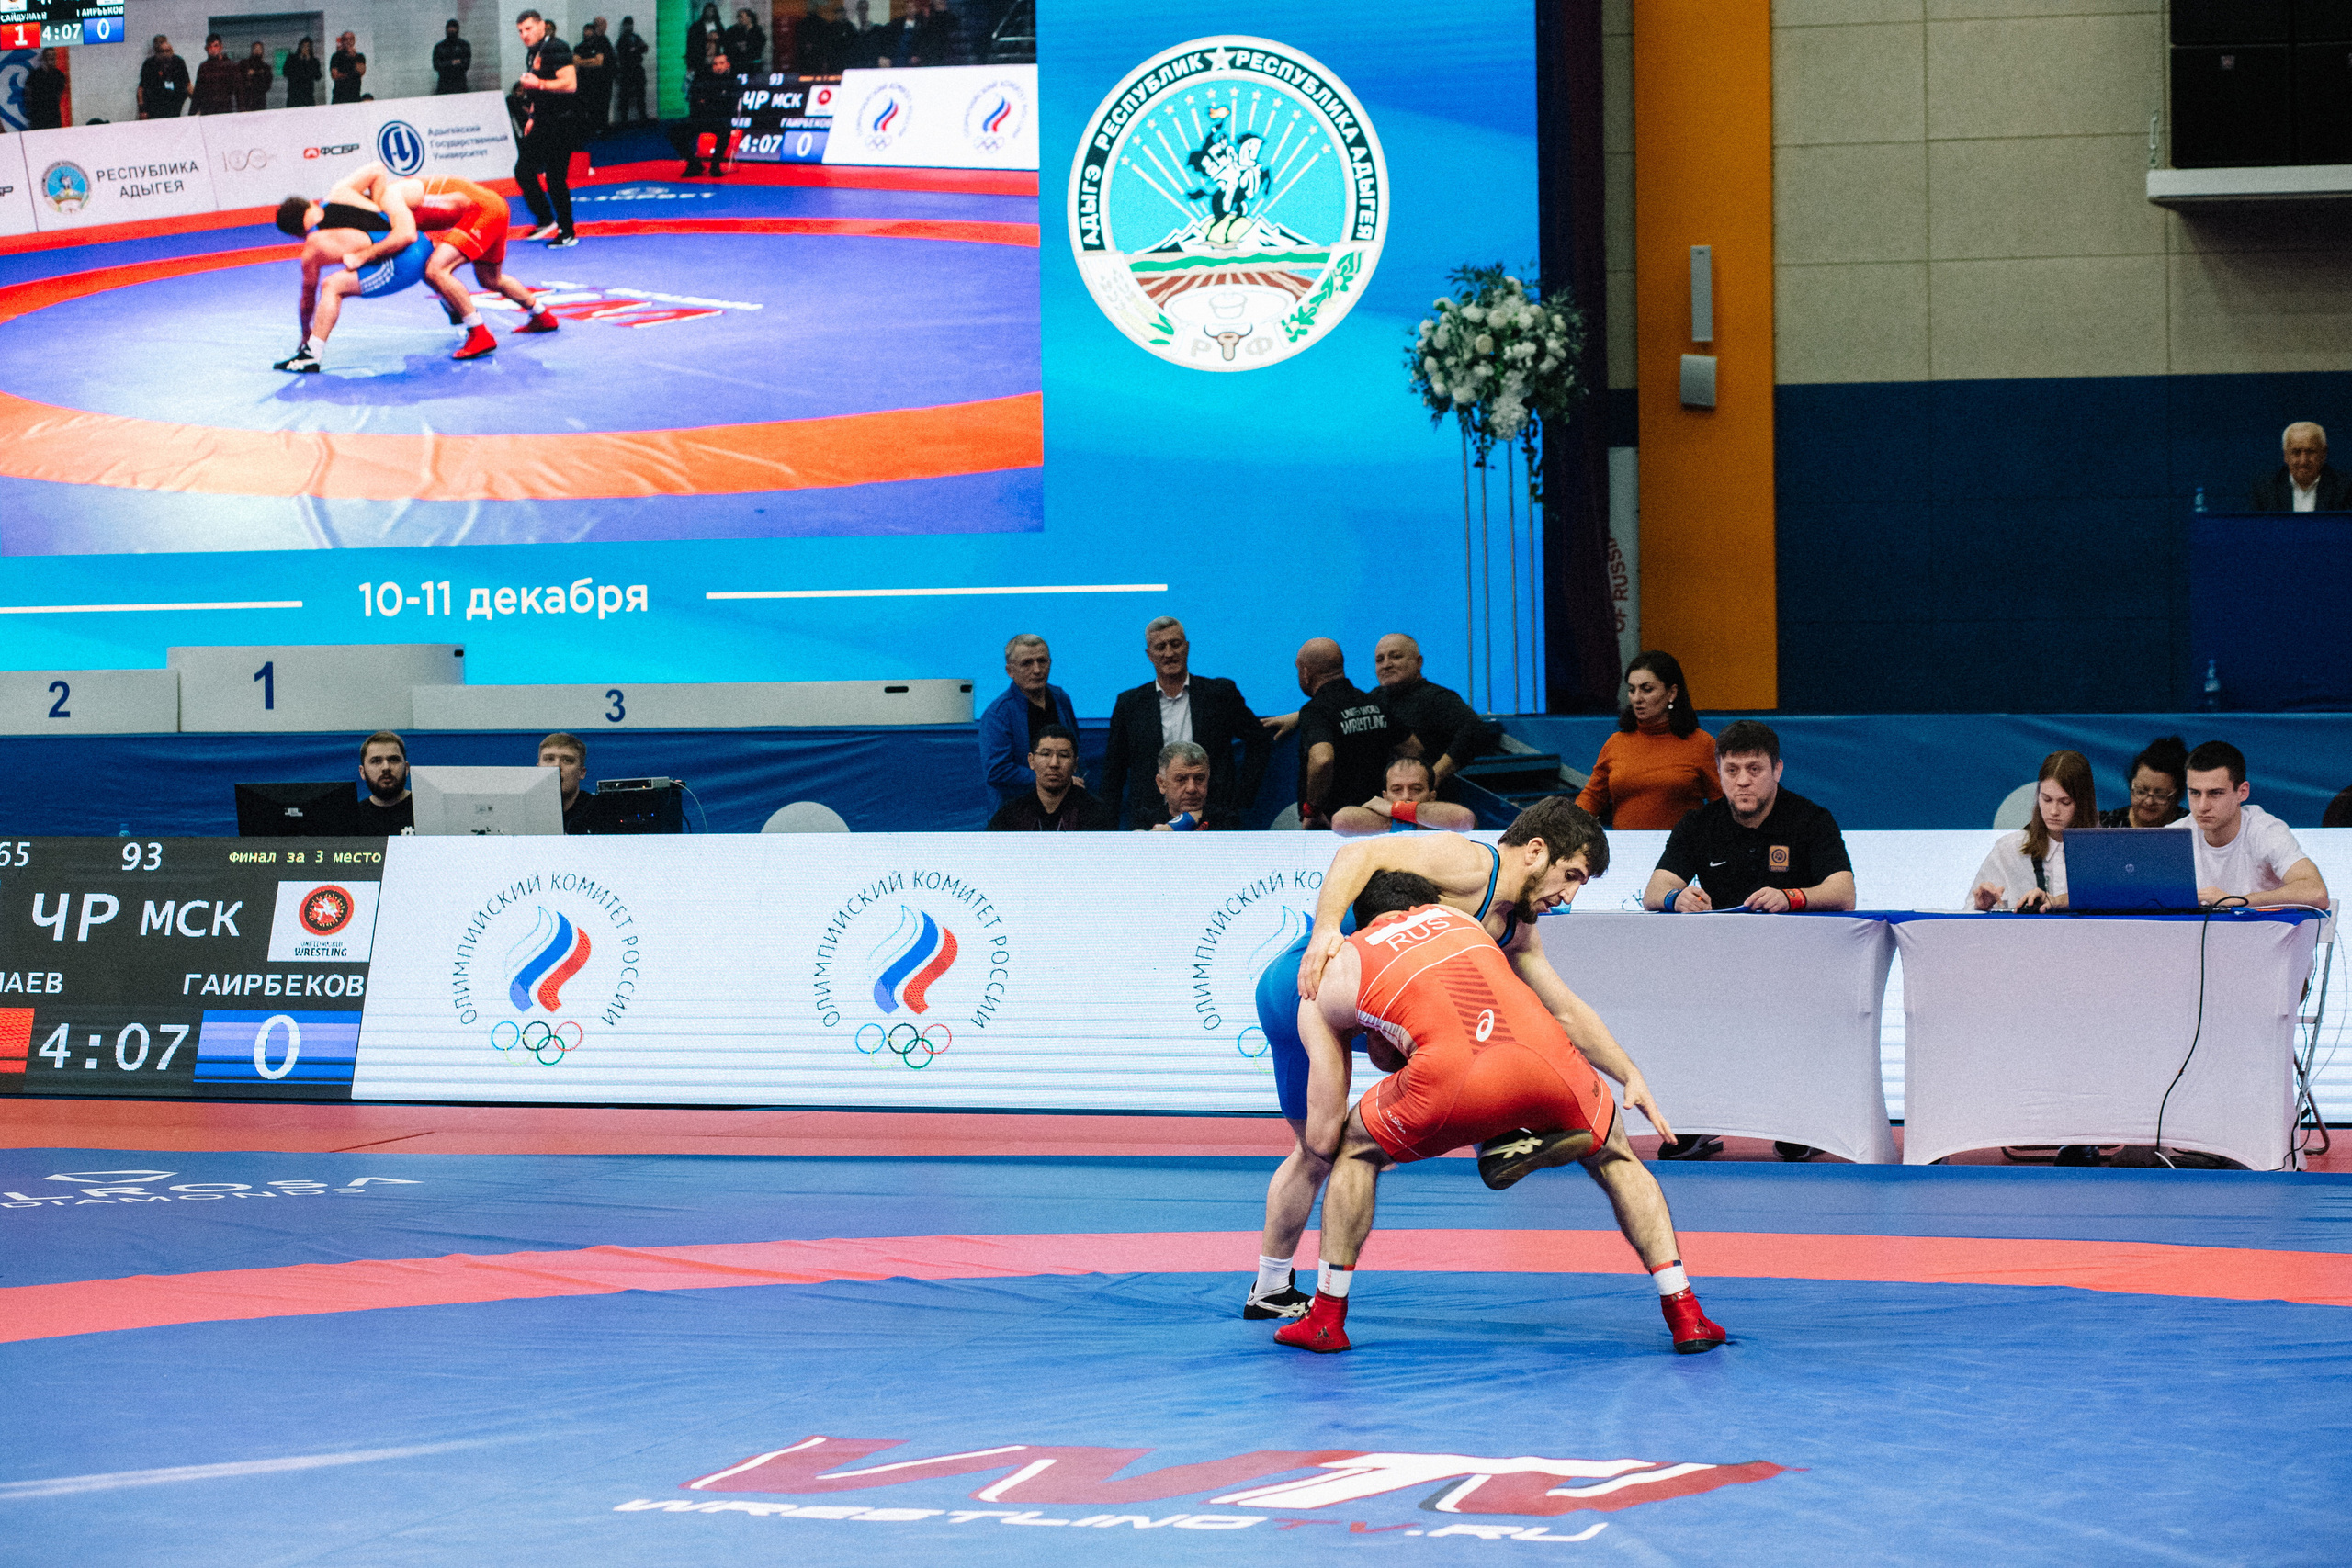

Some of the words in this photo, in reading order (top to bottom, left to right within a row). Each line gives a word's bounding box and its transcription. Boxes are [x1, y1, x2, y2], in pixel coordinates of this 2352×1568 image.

[14, 25, 28, 46] 1
[41, 23, 82, 41] 4:07
[96, 18, 110, 39] 0
[771, 93, 803, 108] МСК
[739, 134, 784, 153] 4:07
[797, 132, 813, 157] 0
[1080, 166, 1102, 245] АДЫГЭ
[1094, 52, 1204, 149] РЕСПУБЛИК
[1235, 50, 1360, 141] РЕСПУБЛИКА
[1351, 147, 1377, 240] АДЫГЕЯ
[96, 161, 199, 182] РЕСПУБЛИКА
[119, 180, 185, 198] АДЫГЕЯ
[358, 581, 451, 617] 10-11
[466, 577, 649, 621] декабря
[48, 681, 71, 717] 2
[254, 661, 274, 710] 1
[605, 689, 626, 723] 3
[121, 842, 163, 871] 93
[287, 852, 305, 863] за
[314, 850, 324, 863] 3
[333, 852, 382, 863] место
[32, 892, 120, 942] ЧР
[140, 900, 243, 937] МСК
[294, 947, 347, 957] WRESTLING
[550, 872, 634, 929] КОМИТЕТ
[601, 935, 640, 1026] РОССИИ
[913, 871, 1002, 929] КОМИТЕТ
[970, 935, 1010, 1029] РОССИИ
[1193, 869, 1284, 1031] ОЛИМПИЙСКИЙ
[1385, 918, 1451, 952] RUS
[182, 974, 365, 997] ГАИРБЕКОВ
[39, 1022, 190, 1071] 4:07
[253, 1014, 301, 1080] 0
